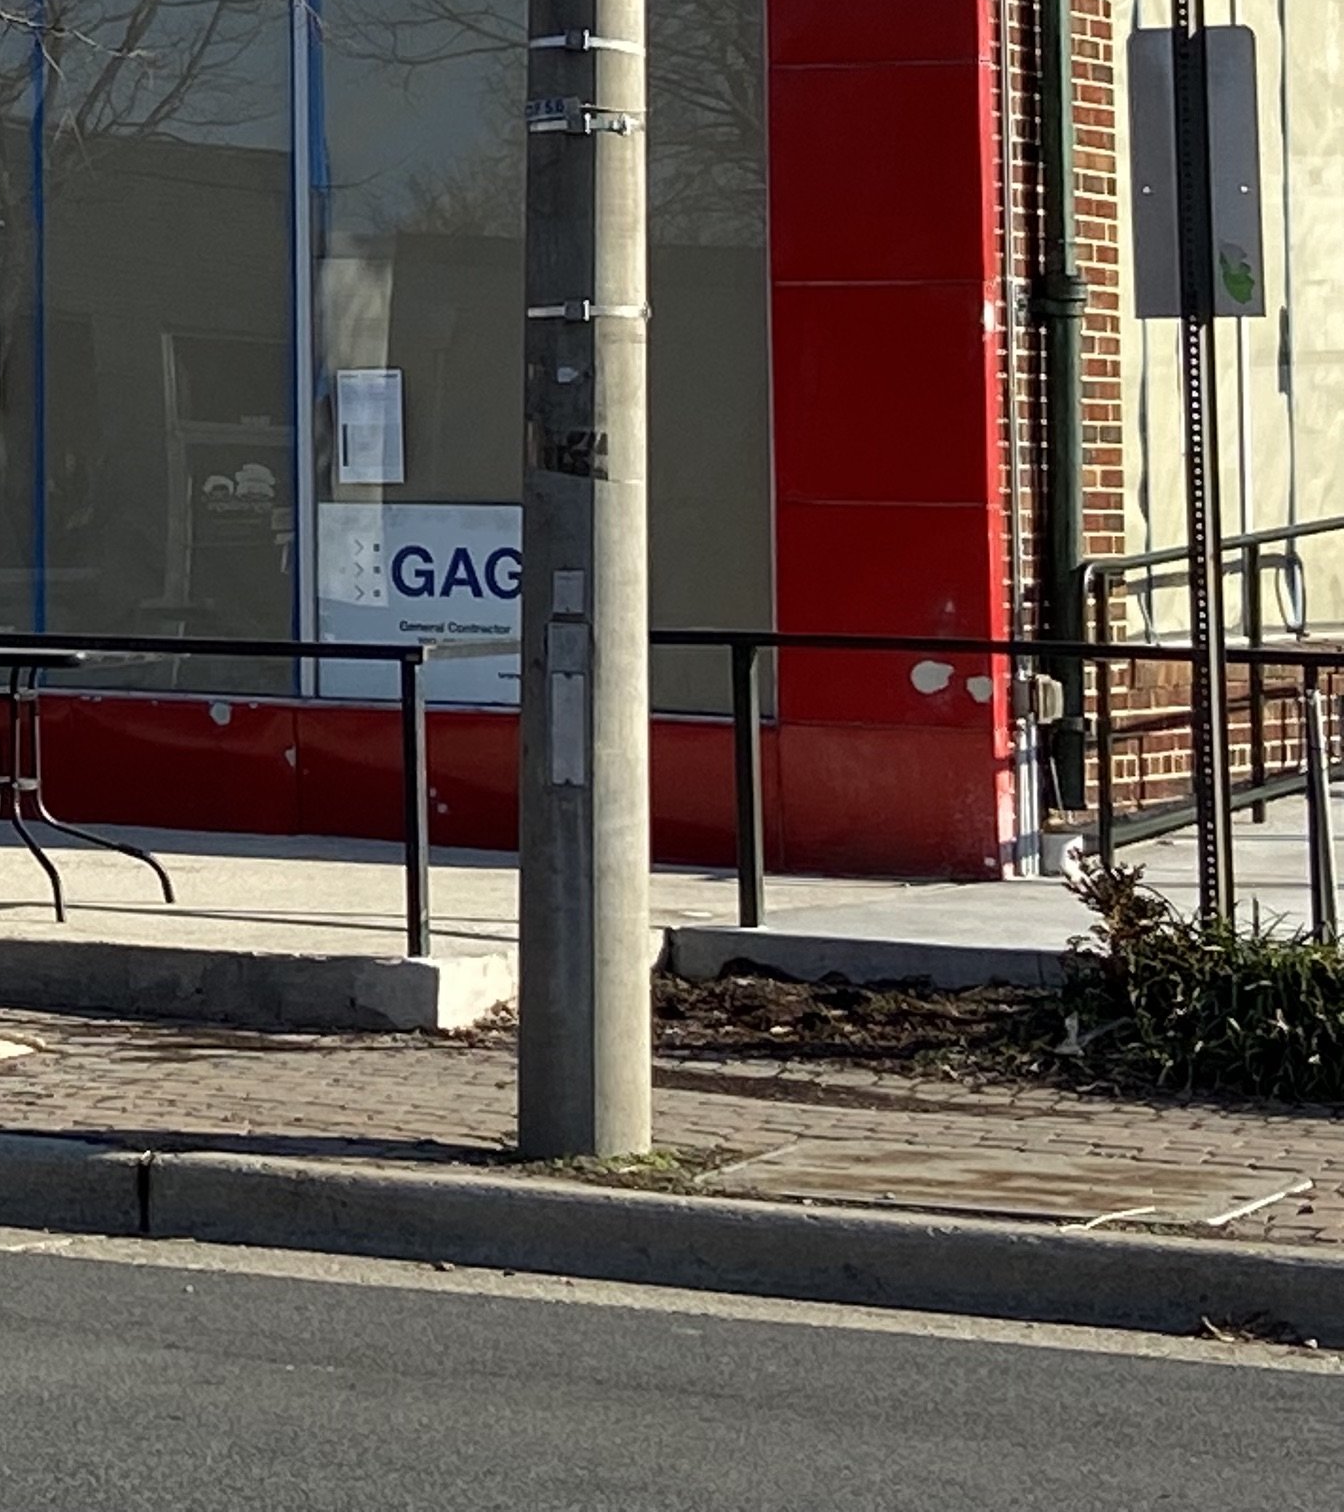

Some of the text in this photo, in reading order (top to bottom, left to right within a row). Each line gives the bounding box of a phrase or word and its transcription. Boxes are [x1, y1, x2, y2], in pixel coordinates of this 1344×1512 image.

[391, 545, 523, 599] GAG
[399, 620, 511, 636] General Contractor
